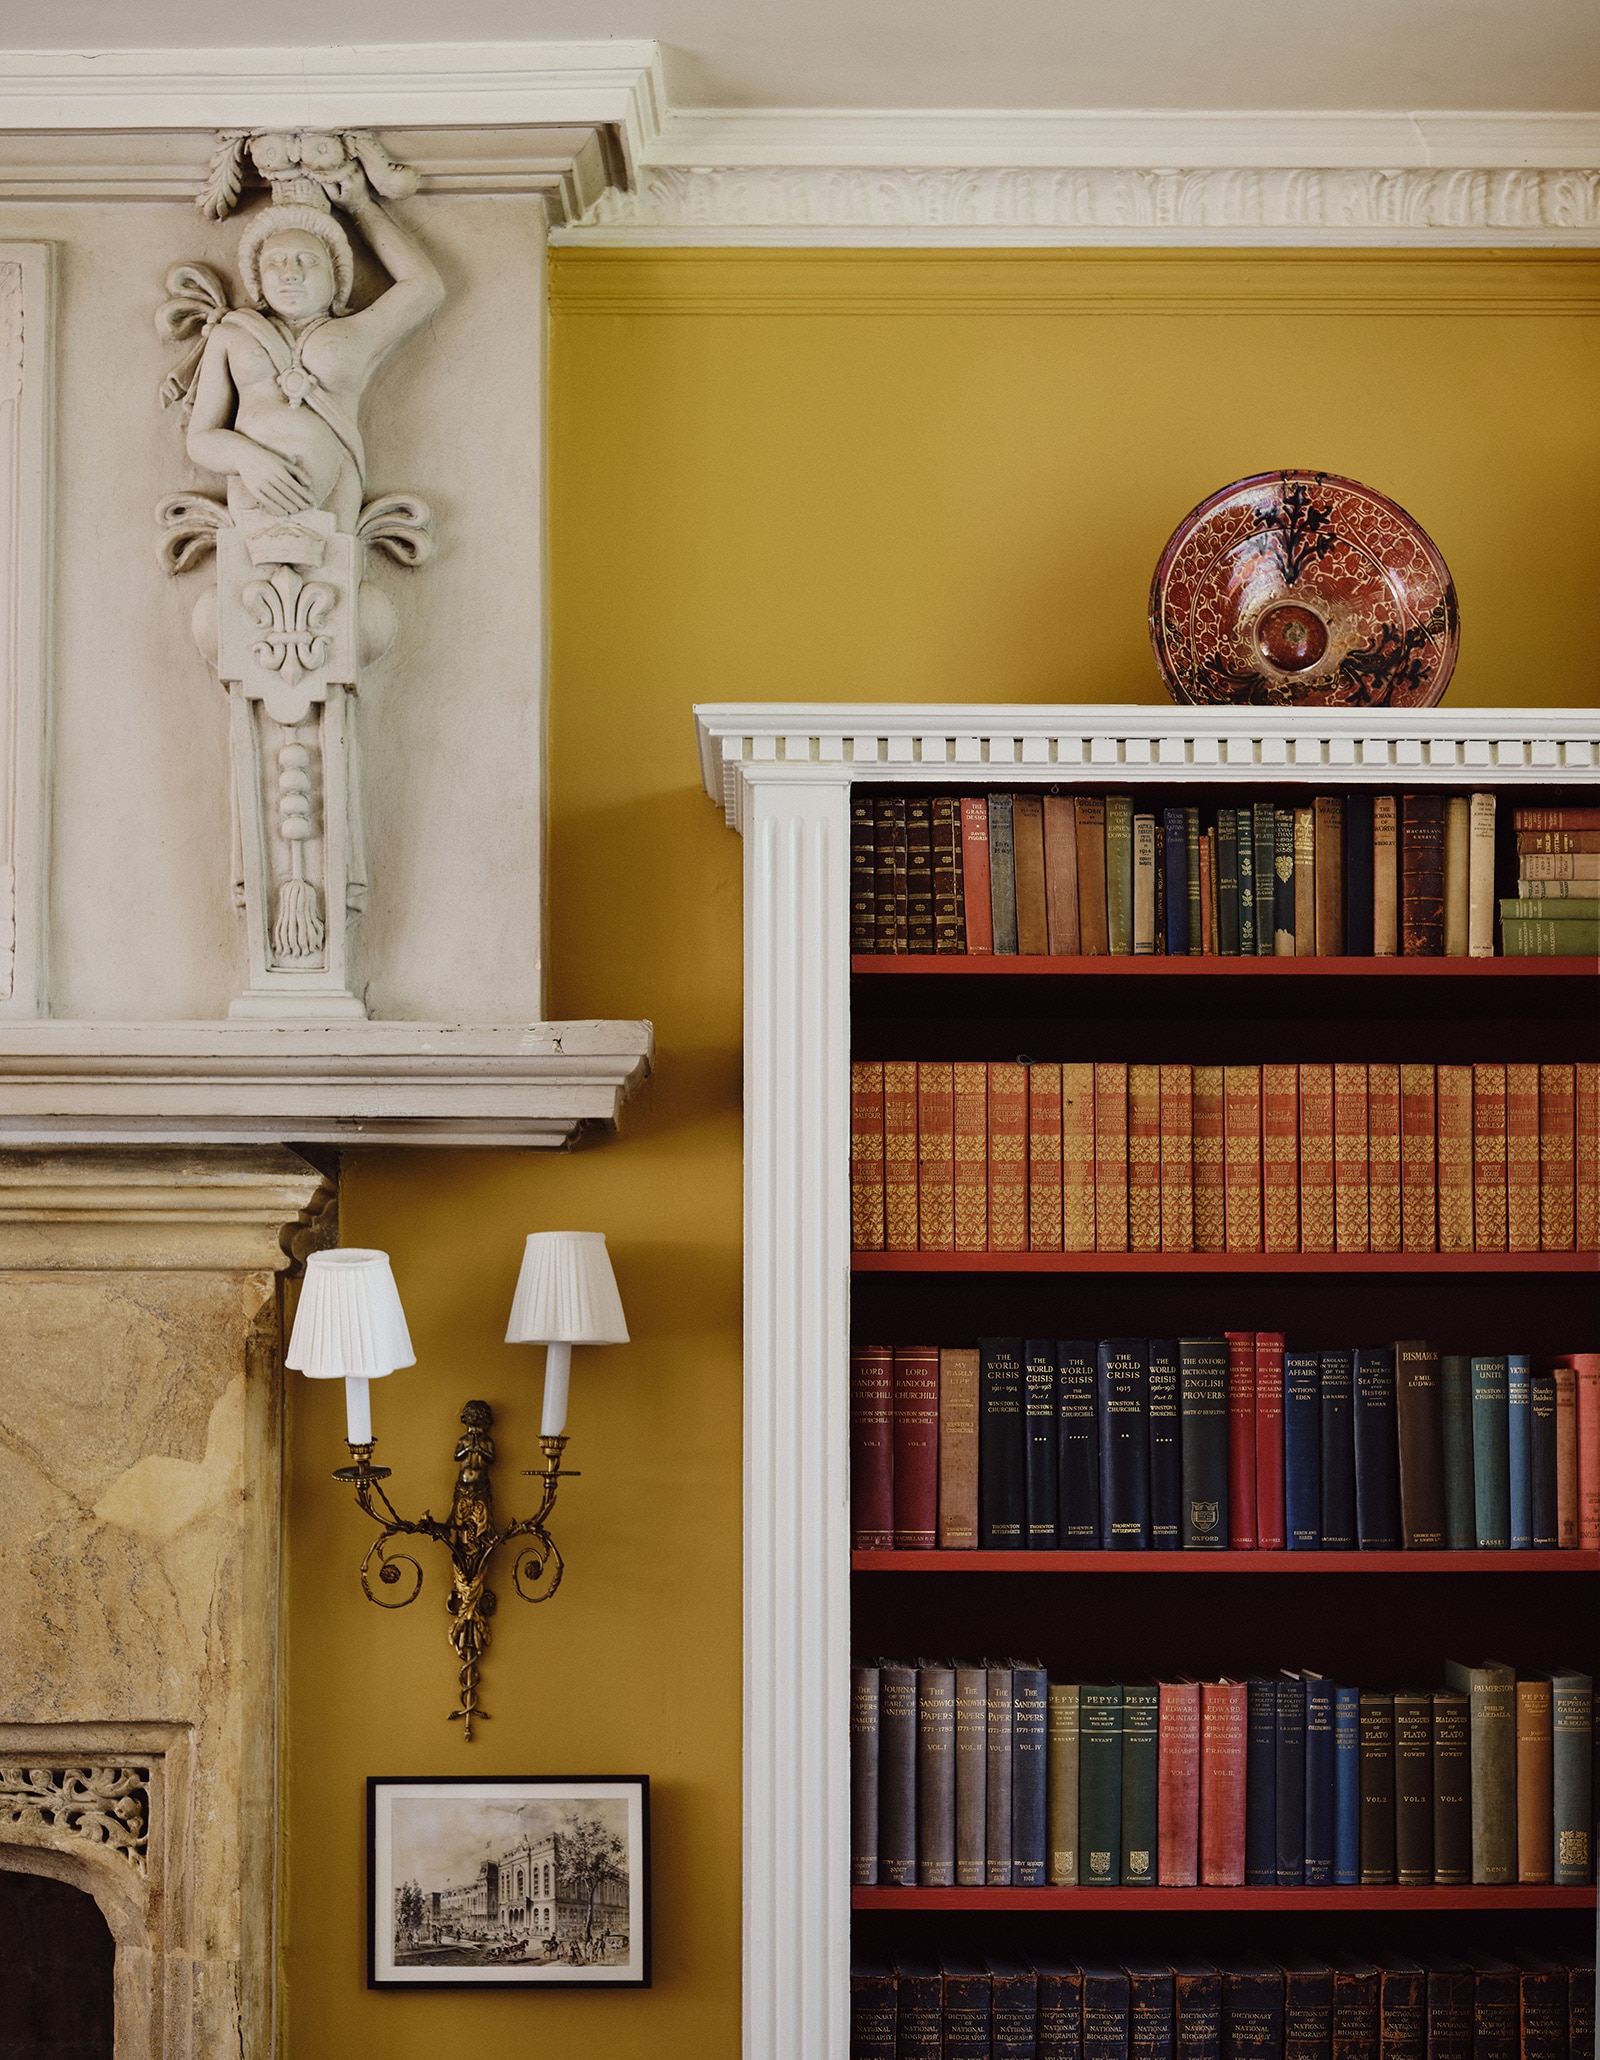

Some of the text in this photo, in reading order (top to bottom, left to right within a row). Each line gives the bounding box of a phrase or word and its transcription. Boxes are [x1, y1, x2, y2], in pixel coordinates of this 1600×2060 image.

[1402, 1352, 1439, 1361] BISMARCK
[987, 1362, 1020, 1370] WORLD
[1026, 1365, 1053, 1373] WORLD
[1106, 1361, 1141, 1369] WORLD
[861, 1368, 884, 1376] LORD
[905, 1368, 928, 1376] LORD
[1149, 1366, 1176, 1374] WORLD
[987, 1371, 1020, 1379] CRISIS
[1106, 1371, 1141, 1379] CRISIS
[1149, 1375, 1177, 1383] CRISIS
[896, 1380, 936, 1388] RANDOLPH
[1060, 1376, 1094, 1384] CRISIS
[1184, 1379, 1224, 1387] ENGLISH
[895, 1391, 937, 1400] CHURCHILL
[1182, 1391, 1226, 1400] PROVERBS
[883, 1684, 916, 1693] JOURNA
[929, 1687, 945, 1696] THE
[1023, 1688, 1038, 1696] THE
[1473, 1684, 1514, 1692] PALMERSTON
[1049, 1696, 1079, 1704] PEPYS
[1087, 1696, 1119, 1704] PEPYS
[1126, 1696, 1157, 1704] PEPYS
[920, 1711, 953, 1720] PAPERS
[957, 1711, 985, 1720] PAPERS
[1016, 1711, 1044, 1721] PAPERS
[1365, 1731, 1389, 1739] PLATO
[1403, 1731, 1427, 1739] PLATO
[1440, 1731, 1464, 1739] PLATO
[1231, 2012, 1272, 2020] DICTIONARY
